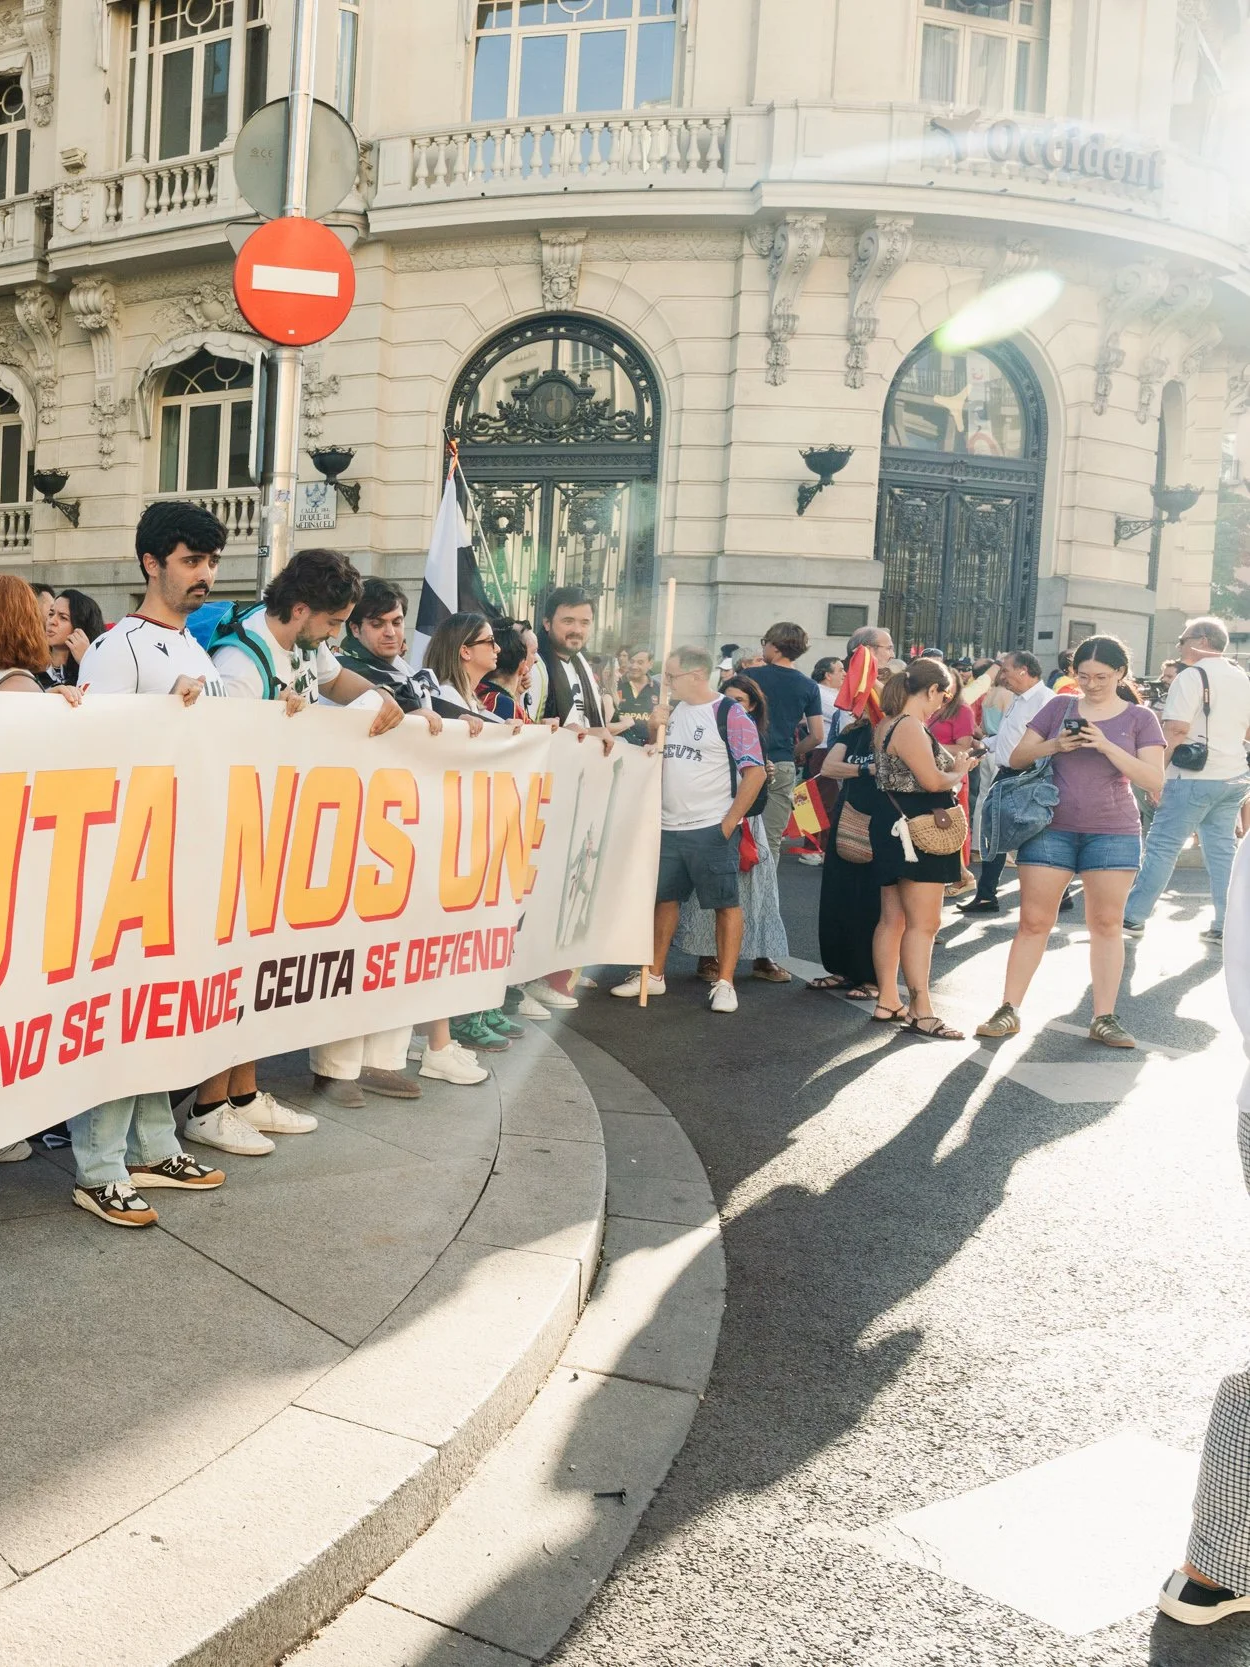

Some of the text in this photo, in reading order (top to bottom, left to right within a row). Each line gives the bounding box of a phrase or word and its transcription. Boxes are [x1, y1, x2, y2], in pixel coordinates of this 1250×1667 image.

[986, 118, 1166, 190] Occident
[295, 520, 335, 529] MEDINACELI
[299, 513, 322, 521] DUQUE
[663, 744, 702, 762] CEUTA
[214, 765, 420, 946] NOS
[57, 993, 111, 1065] SE
[121, 966, 245, 1044] VENDE,
[254, 949, 355, 1013] CEUTA
[362, 942, 396, 992] SE
